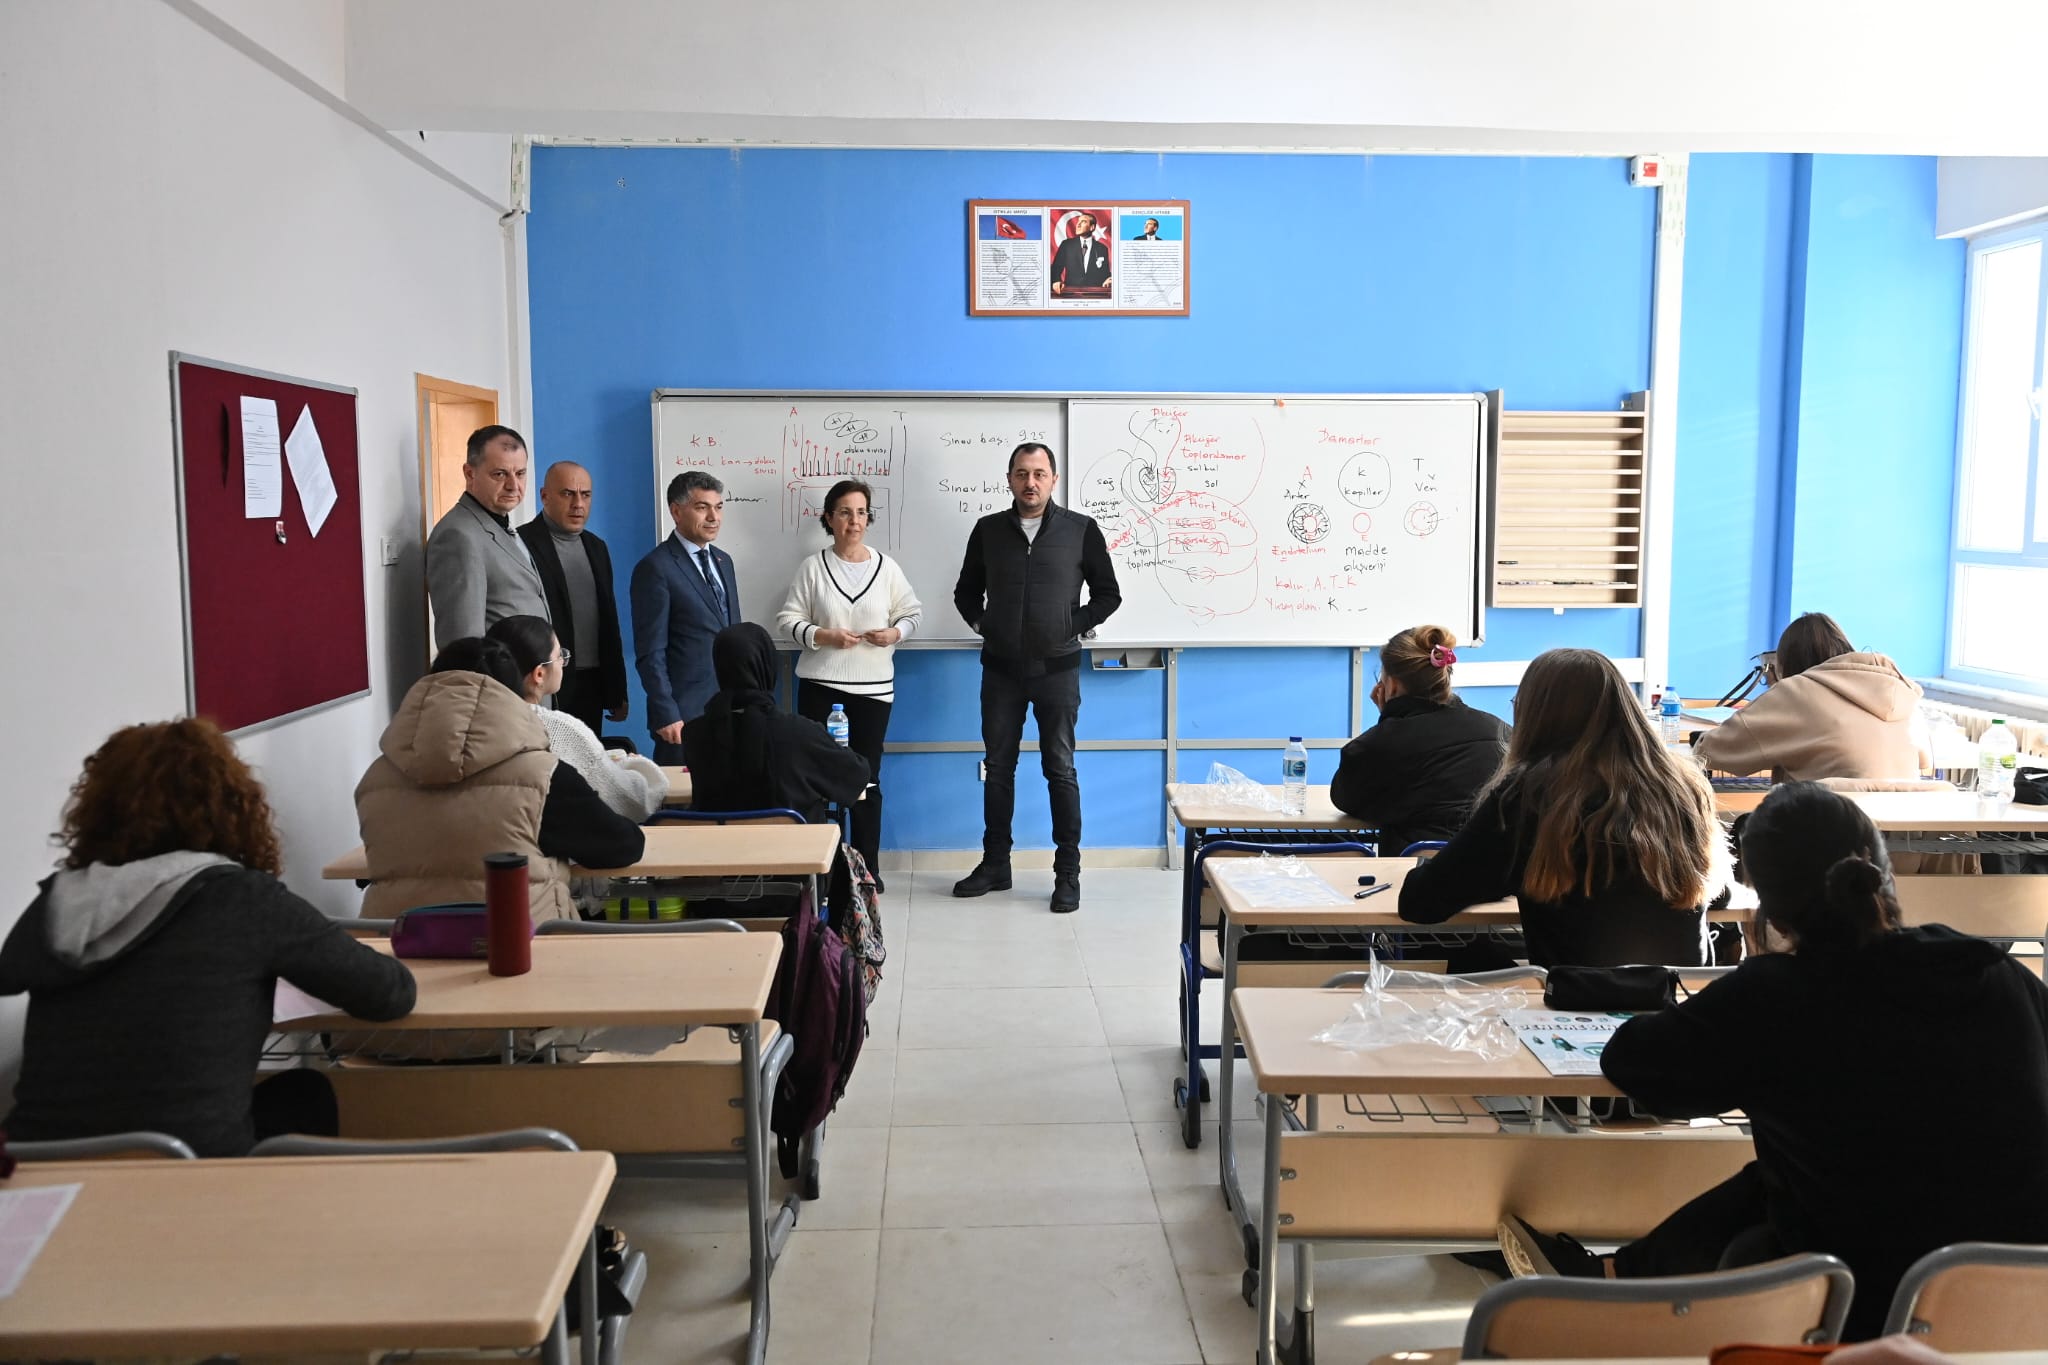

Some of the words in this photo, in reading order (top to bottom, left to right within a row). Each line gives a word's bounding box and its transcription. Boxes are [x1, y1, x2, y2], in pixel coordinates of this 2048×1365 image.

[789, 406, 798, 418] A
[892, 410, 908, 421] T
[1412, 458, 1425, 472] T
[1302, 465, 1312, 480] A
[938, 478, 977, 493] Sınav
